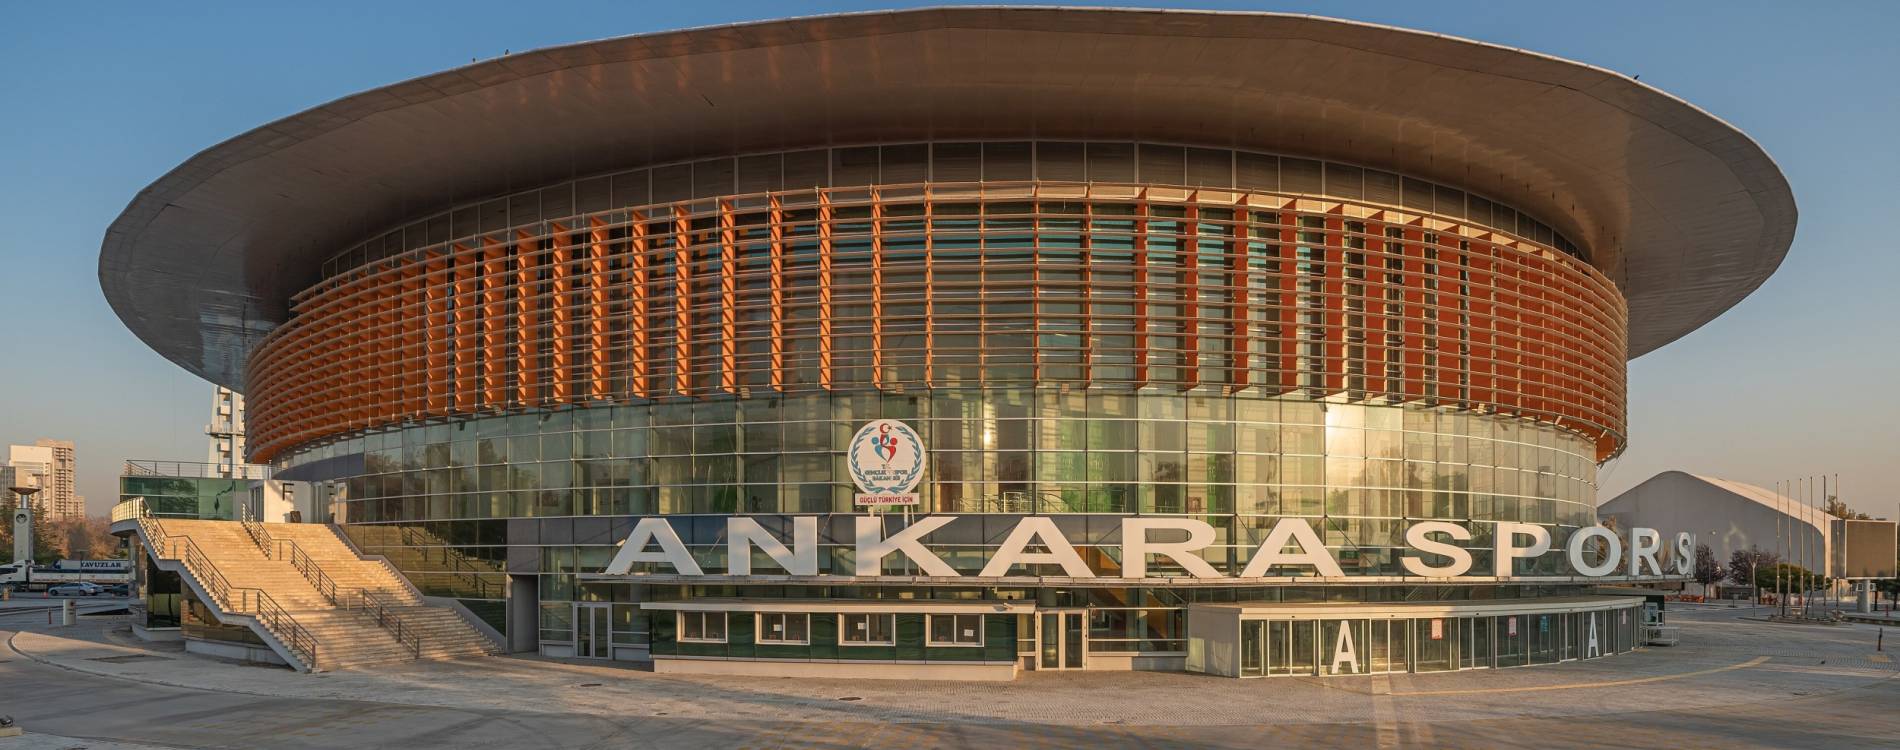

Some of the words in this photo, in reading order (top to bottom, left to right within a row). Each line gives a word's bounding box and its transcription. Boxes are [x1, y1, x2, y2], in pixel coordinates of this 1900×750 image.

[282, 483, 294, 500] F
[604, 516, 1346, 577] ANKARA
[1401, 521, 1662, 577] SPOR
[1332, 620, 1359, 674] A
[1588, 612, 1600, 658] A
